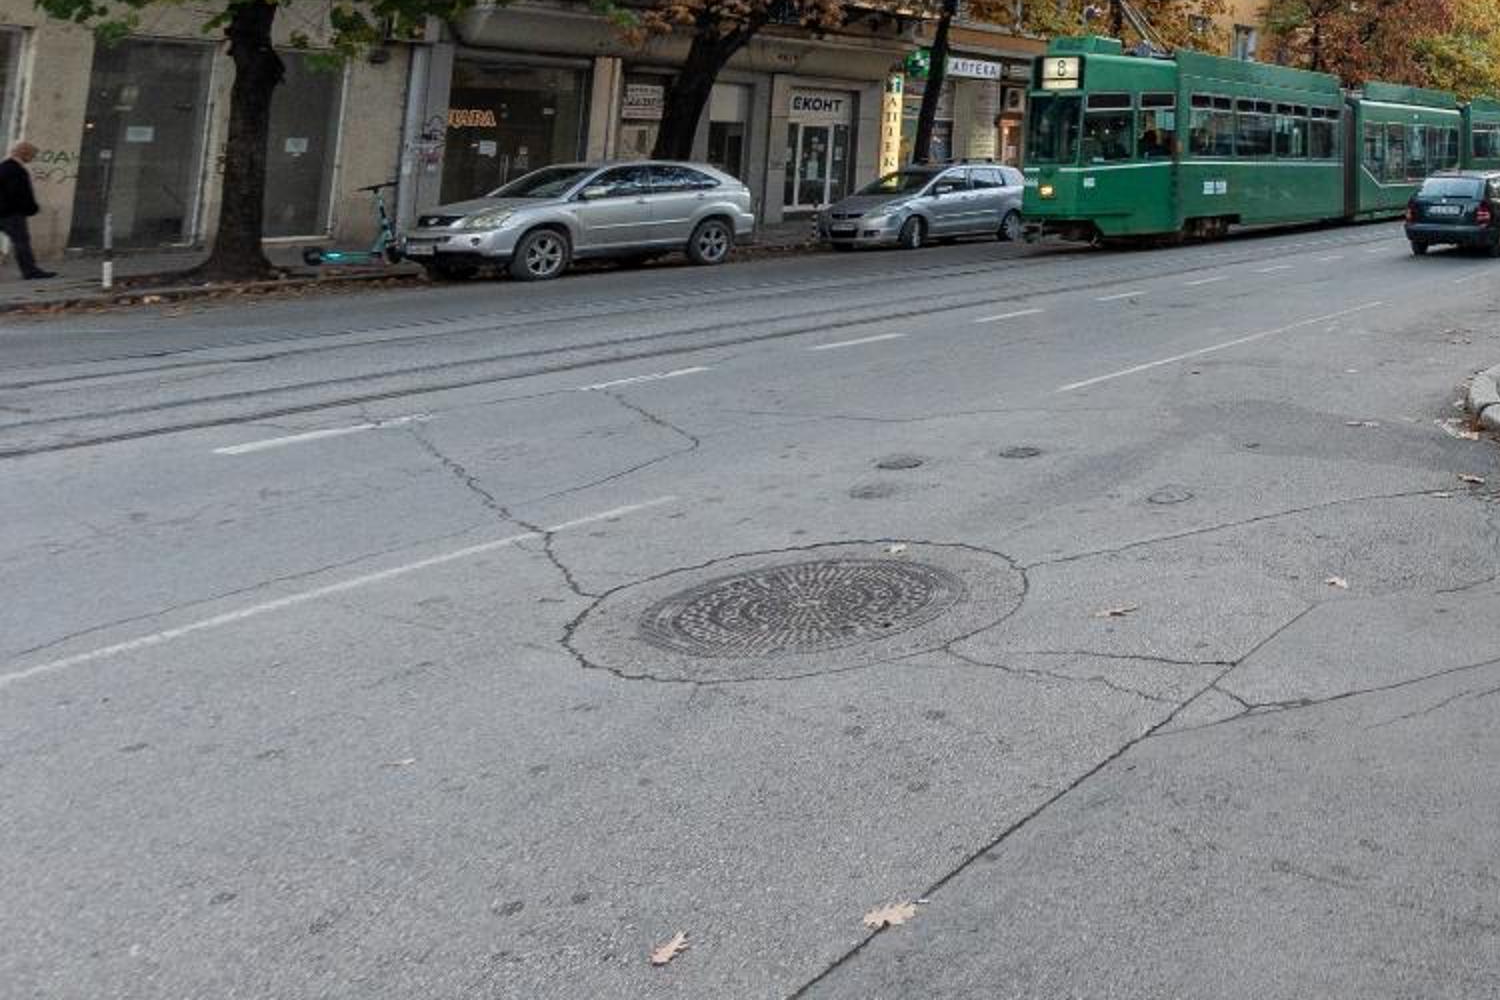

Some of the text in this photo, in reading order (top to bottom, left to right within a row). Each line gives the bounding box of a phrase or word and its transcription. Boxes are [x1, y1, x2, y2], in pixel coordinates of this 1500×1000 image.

[953, 61, 997, 76] АПТЕКА
[1056, 59, 1067, 77] 8
[793, 96, 843, 113] ЕКОНТ
